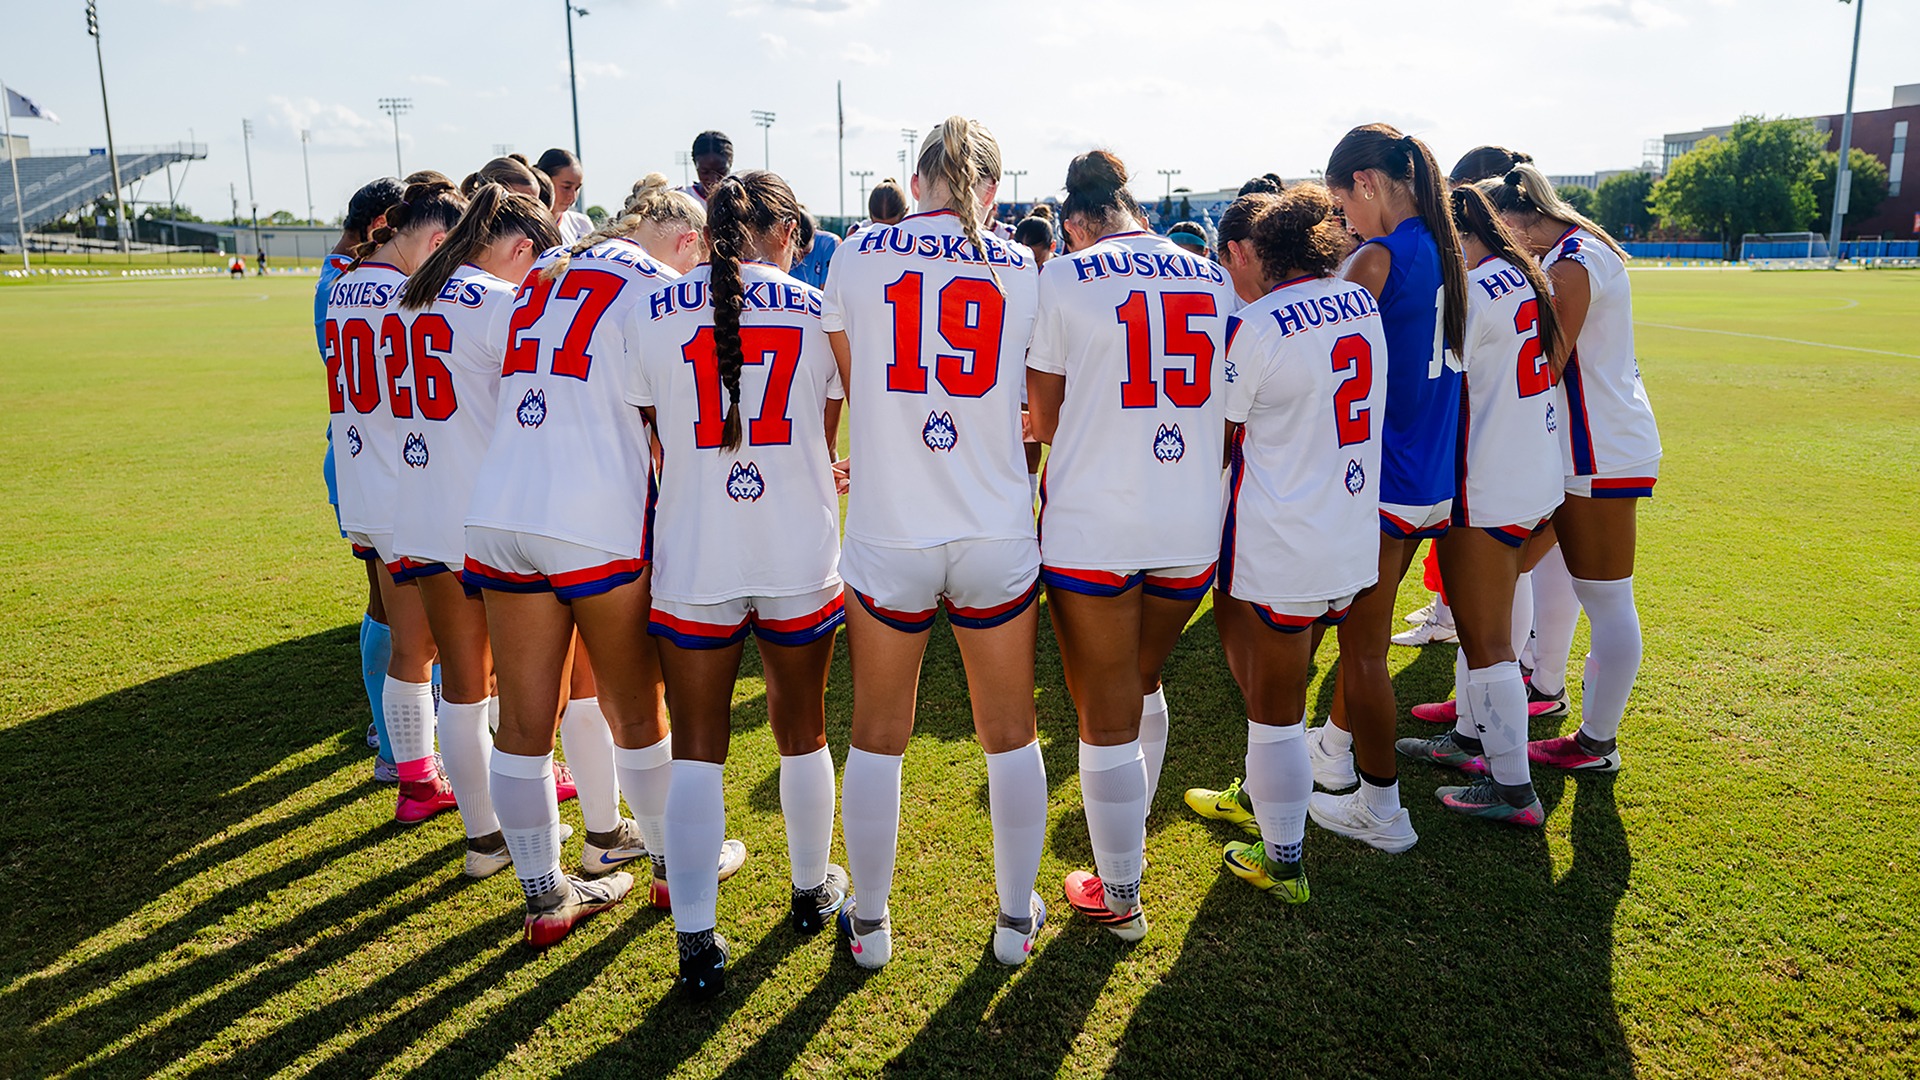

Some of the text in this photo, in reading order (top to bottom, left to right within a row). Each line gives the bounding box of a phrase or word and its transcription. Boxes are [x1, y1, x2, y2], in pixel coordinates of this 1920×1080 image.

[649, 281, 823, 321] HUKIES
[858, 226, 1026, 270] HUSKIES
[1072, 251, 1225, 287] HUSKIES
[325, 317, 382, 415] 20
[380, 312, 459, 422] 26
[500, 266, 629, 383] 27
[884, 270, 1006, 398] 19
[1115, 289, 1218, 409] 15
[681, 325, 803, 449] 17
[1330, 332, 1374, 449] 2
